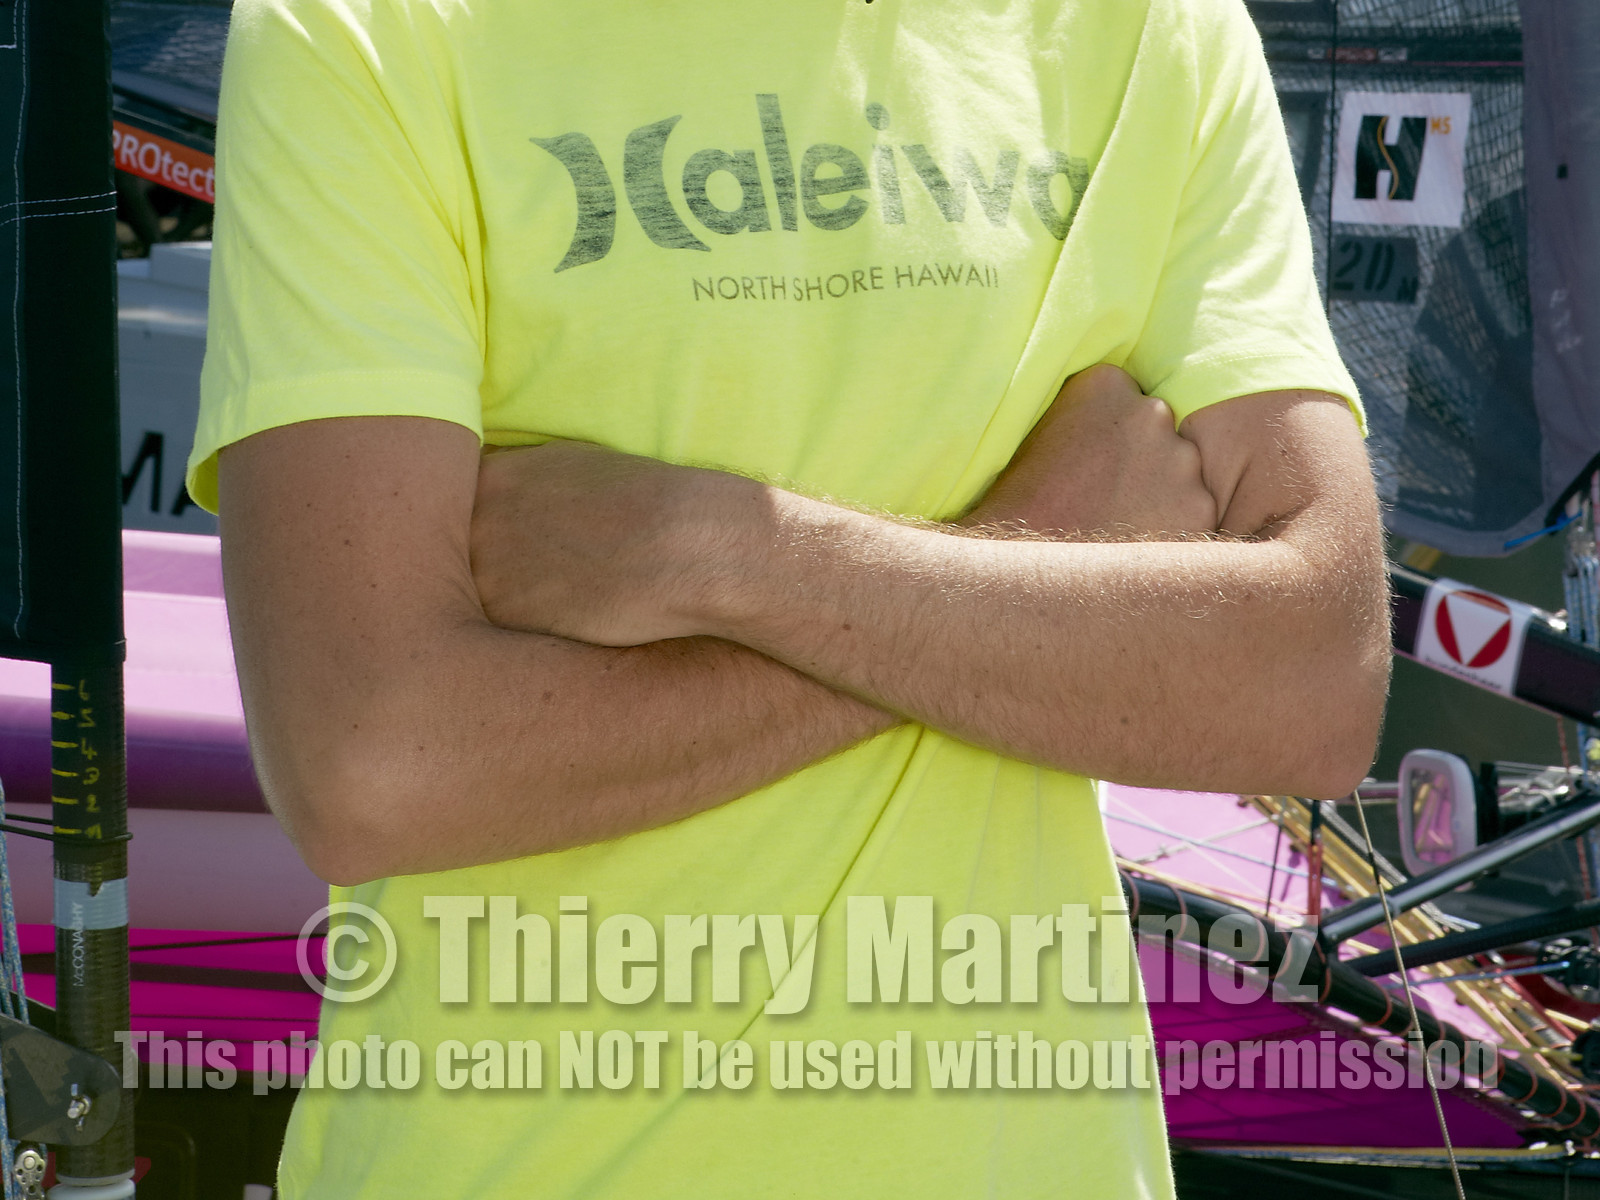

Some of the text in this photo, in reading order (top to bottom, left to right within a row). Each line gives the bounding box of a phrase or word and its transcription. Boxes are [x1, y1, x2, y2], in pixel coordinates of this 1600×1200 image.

[692, 263, 999, 301] NORTH SHORE HAWAII
[81, 738, 98, 760] 4
[86, 794, 99, 812] 2
